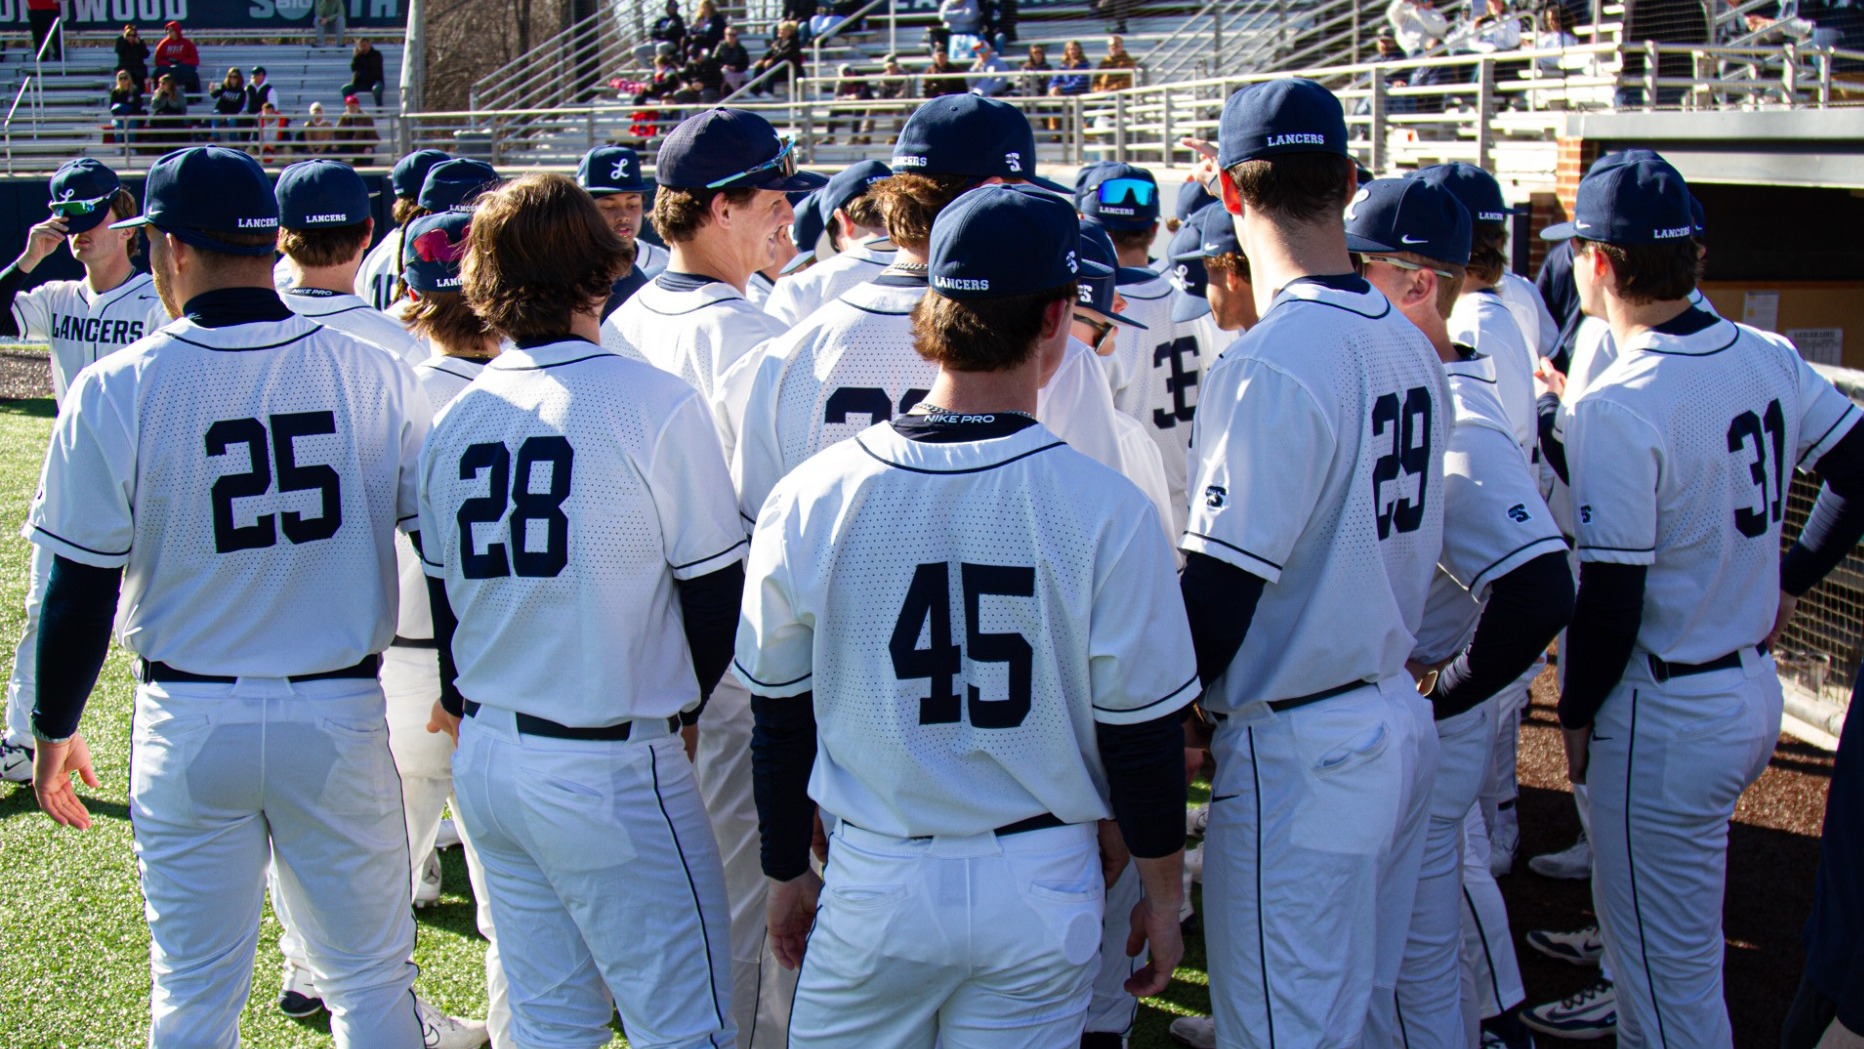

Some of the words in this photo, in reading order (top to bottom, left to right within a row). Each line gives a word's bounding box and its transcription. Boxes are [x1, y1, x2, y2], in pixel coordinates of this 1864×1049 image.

[1267, 133, 1324, 147] LANCERS
[305, 213, 347, 223] LANCERS
[1098, 206, 1135, 216] LANCERS
[238, 217, 278, 228] LANCERS
[934, 275, 989, 291] LANCERS
[312, 288, 332, 296] PRO
[52, 312, 144, 345] LANCERS
[923, 414, 957, 424] NIKE
[960, 414, 995, 424] PRO
[1372, 386, 1432, 541] 29
[1727, 398, 1786, 539] 31
[204, 410, 342, 554] 25
[456, 435, 574, 580] 28
[888, 561, 1035, 730] 45
